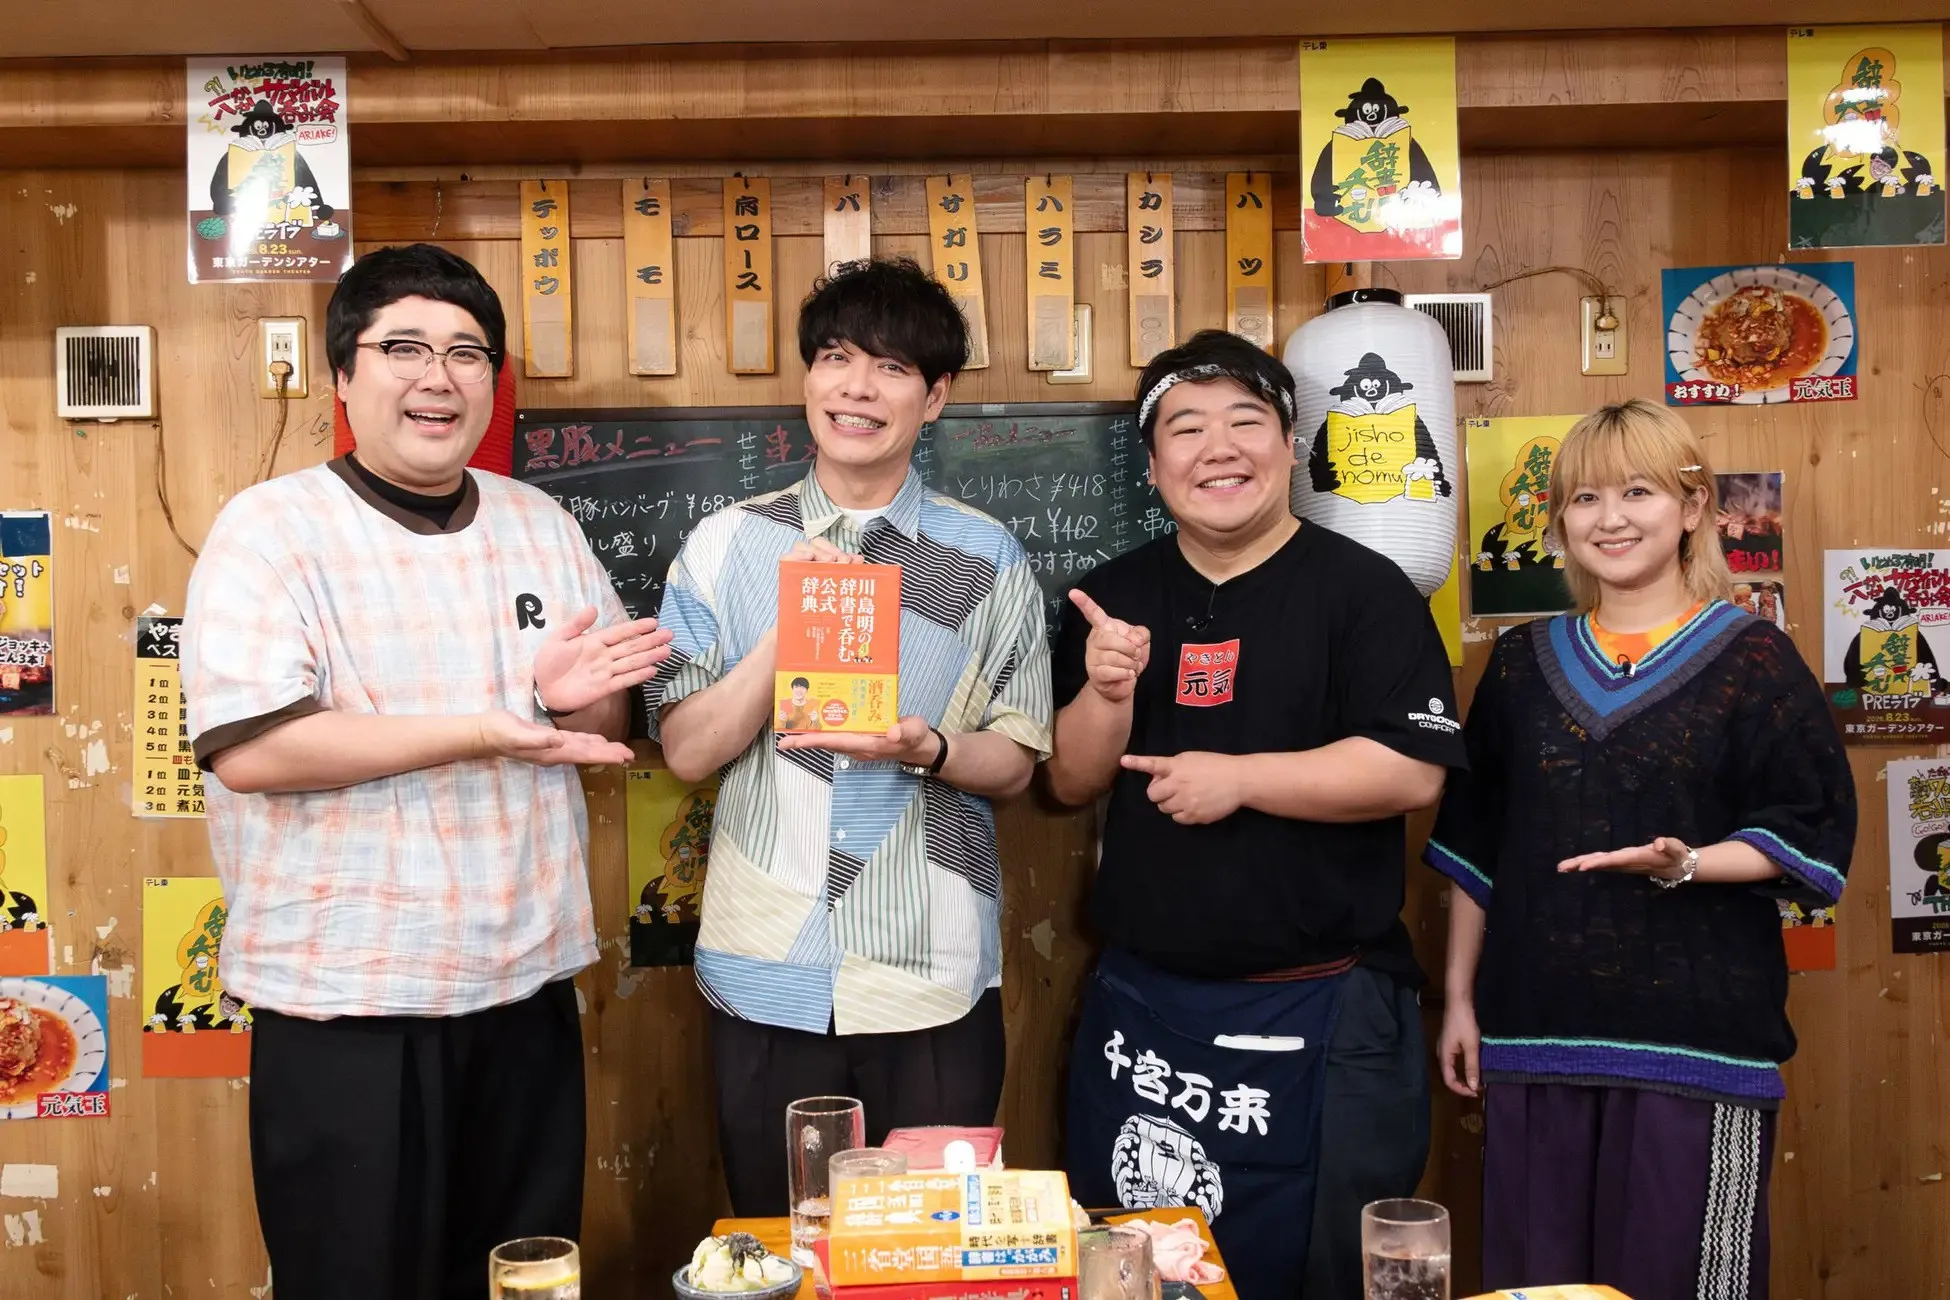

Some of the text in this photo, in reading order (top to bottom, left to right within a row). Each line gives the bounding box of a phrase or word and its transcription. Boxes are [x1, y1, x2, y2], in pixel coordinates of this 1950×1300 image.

[1303, 42, 1327, 50] テレ東
[298, 129, 336, 140] ARIAKE!
[634, 197, 664, 286] モモ
[938, 193, 970, 281] サガリ
[1036, 194, 1064, 280] ハラミ
[1138, 191, 1164, 279] カシラ
[1236, 191, 1264, 277] ハツ
[258, 243, 287, 255] 8.23
[532, 198, 560, 296] テッポウ
[735, 196, 762, 292] 肩ロース
[212, 256, 331, 268] 東京ガーデンシアター
[1673, 384, 1741, 400] おすすめ!
[1793, 379, 1852, 399] 元気玉
[1468, 420, 1490, 428] テレ東
[524, 424, 722, 471] 黒豚メニュー
[1337, 424, 1405, 452] jisho
[1347, 447, 1388, 467] de
[1341, 469, 1404, 485] nomu
[957, 474, 1044, 505] とりわさ
[1050, 473, 1107, 502] ¥418
[552, 490, 675, 523] 豚ハンバーグ
[1046, 507, 1099, 543] ¥462
[588, 530, 658, 559] し盛り
[801, 576, 819, 614] 辞典
[819, 577, 838, 614] 公式
[515, 592, 546, 631] R
[837, 578, 858, 663] 辞書で呑む
[856, 579, 876, 643] 川島明の
[147, 644, 177, 657] ベス
[1184, 648, 1234, 665] やきとん
[149, 678, 169, 688] 1位
[1181, 669, 1233, 696] 元気
[148, 694, 168, 704] 2位
[1862, 692, 1925, 711] PREライブ
[147, 710, 168, 720] 3位
[1408, 712, 1460, 730] DRYGOODS
[1886, 712, 1910, 721] 8.23
[146, 726, 168, 735] 4位
[1845, 723, 1945, 734] 東京ガーデンシアター
[146, 742, 167, 752] 5位
[147, 770, 166, 779] 1位
[628, 772, 651, 780] テレ東
[146, 784, 205, 797] 2位 元気
[145, 800, 205, 813] 3位 煮込
[145, 878, 168, 887] テレ東
[1104, 1029, 1271, 1137] 千客万来
[41, 1093, 106, 1117] 元気玉
